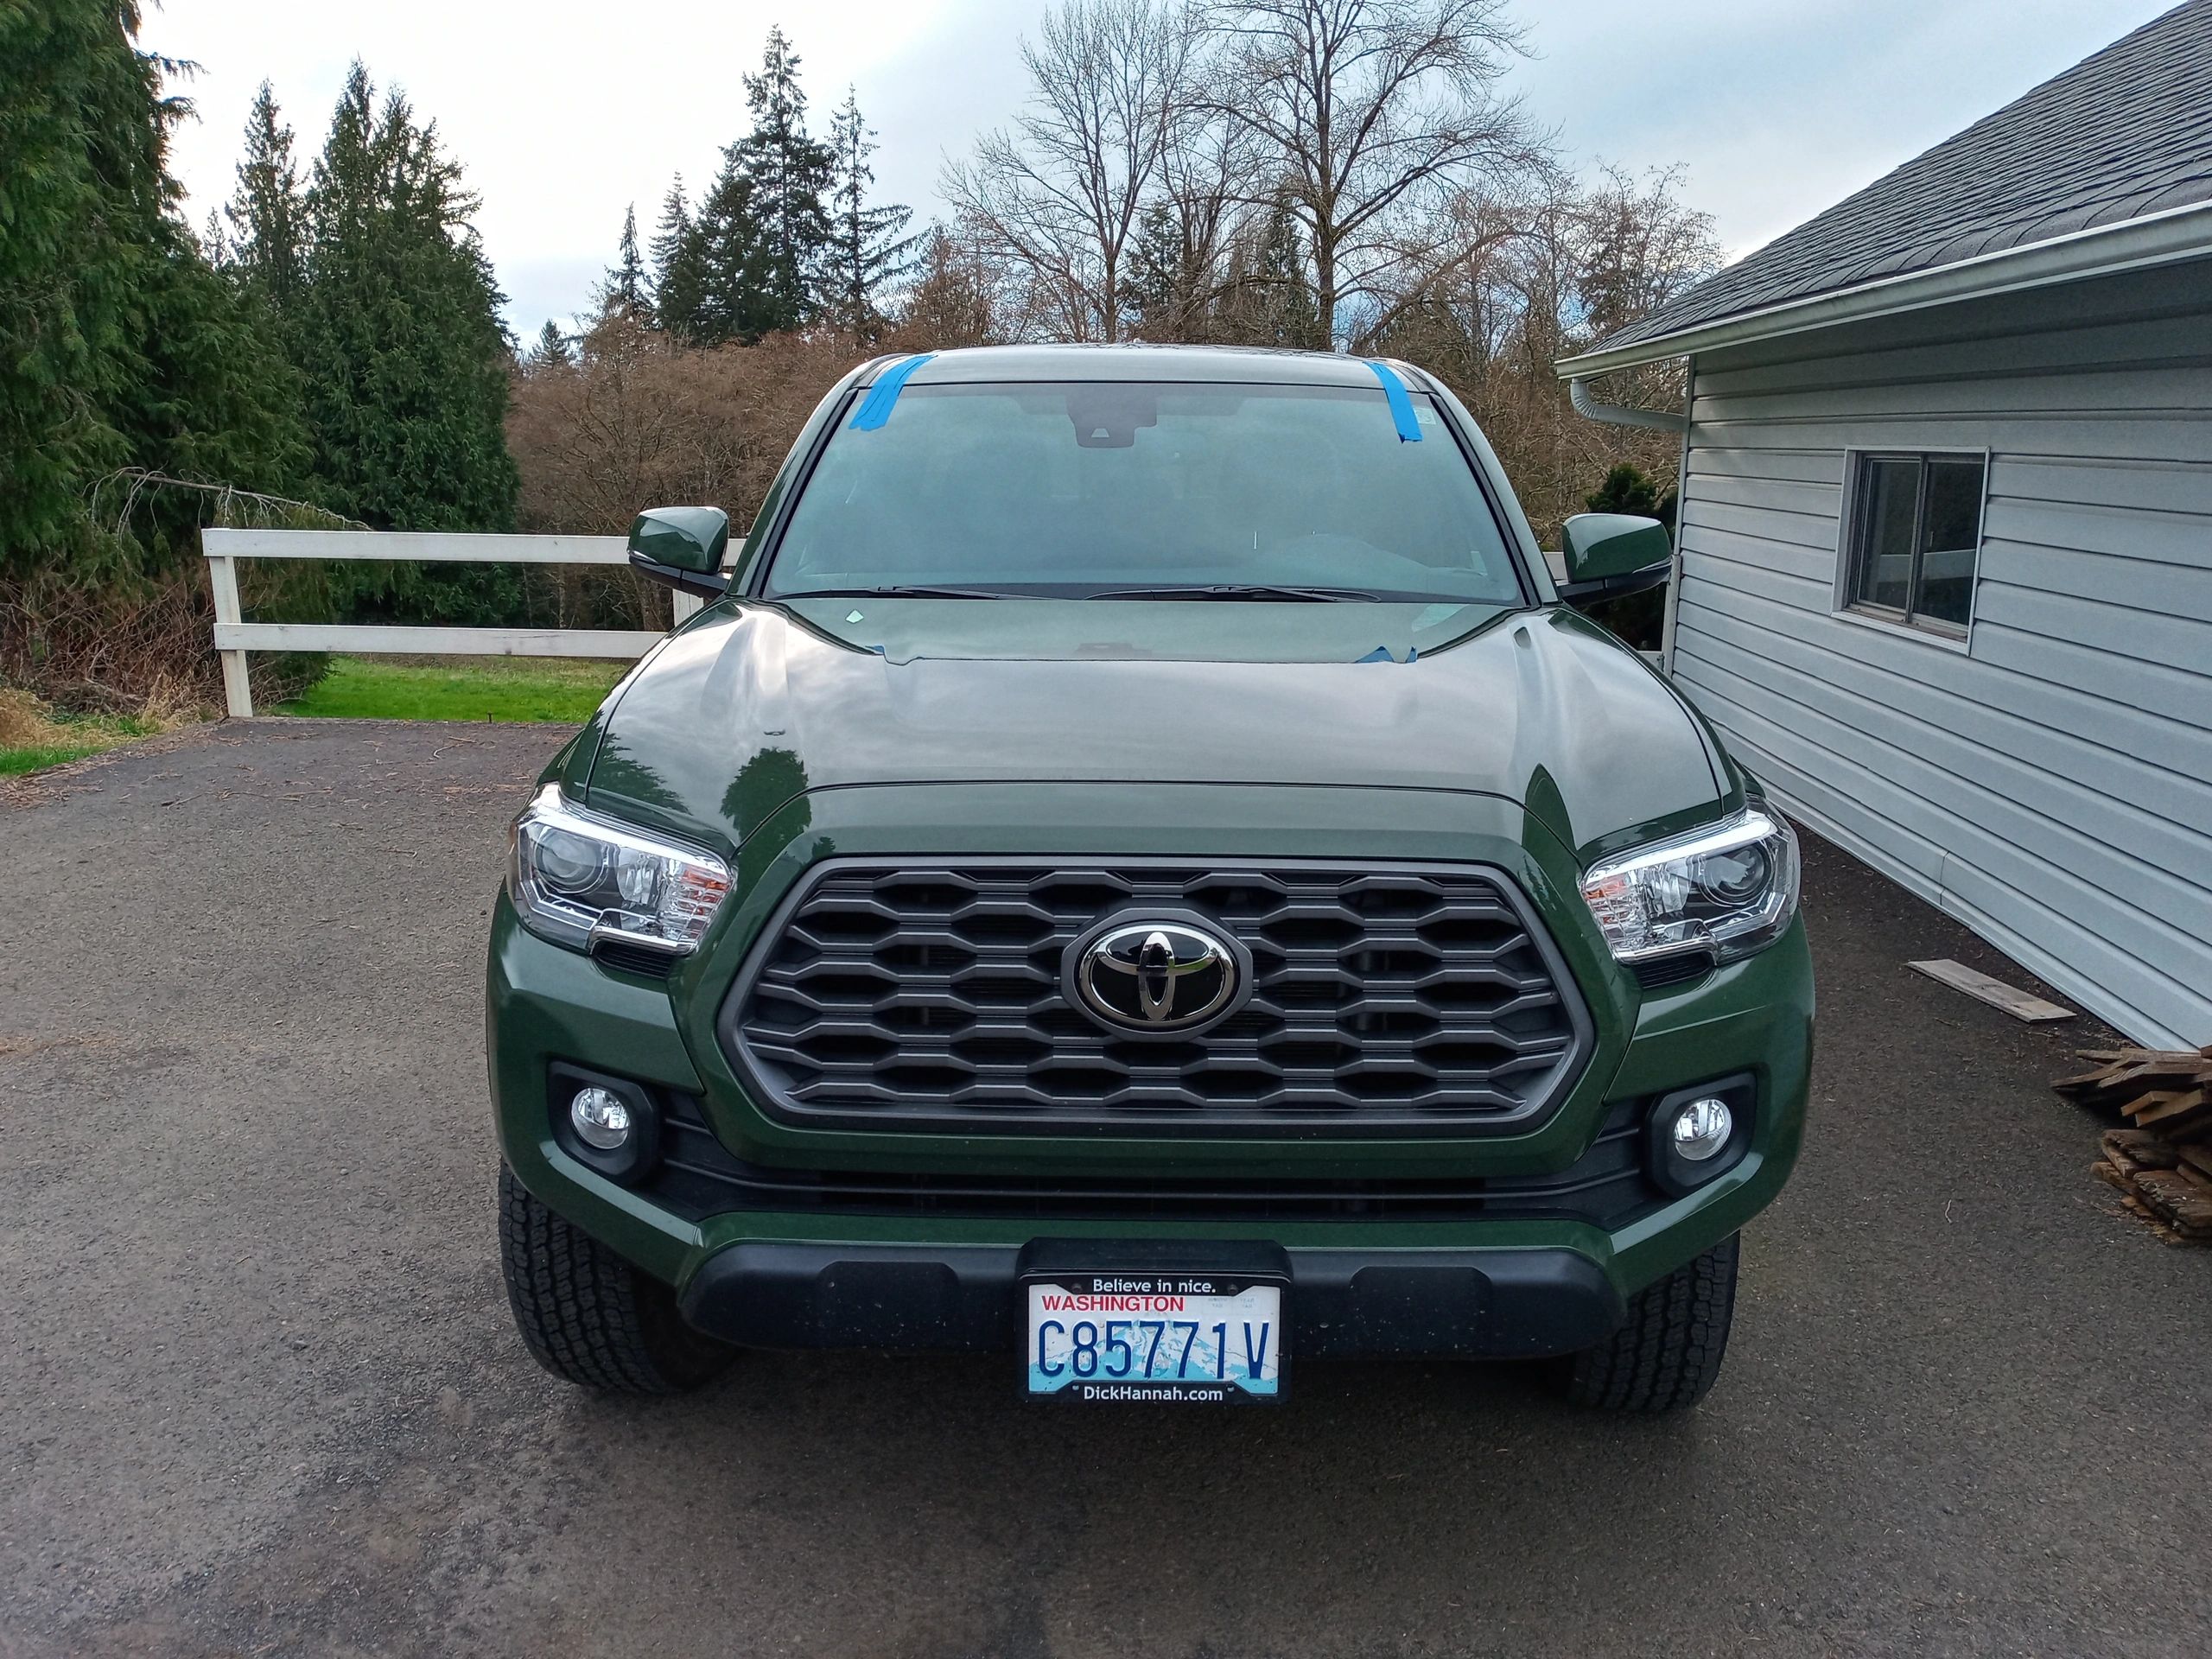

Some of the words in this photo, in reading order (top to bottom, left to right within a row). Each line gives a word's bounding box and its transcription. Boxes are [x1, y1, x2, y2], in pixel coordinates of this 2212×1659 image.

[1093, 1279, 1151, 1292] Believe
[1156, 1279, 1173, 1292] in
[1178, 1279, 1216, 1293] nice.
[1042, 1295, 1184, 1311] WASHINGTON
[1038, 1319, 1269, 1379] C85771V
[1084, 1386, 1223, 1401] DickHannah.com
